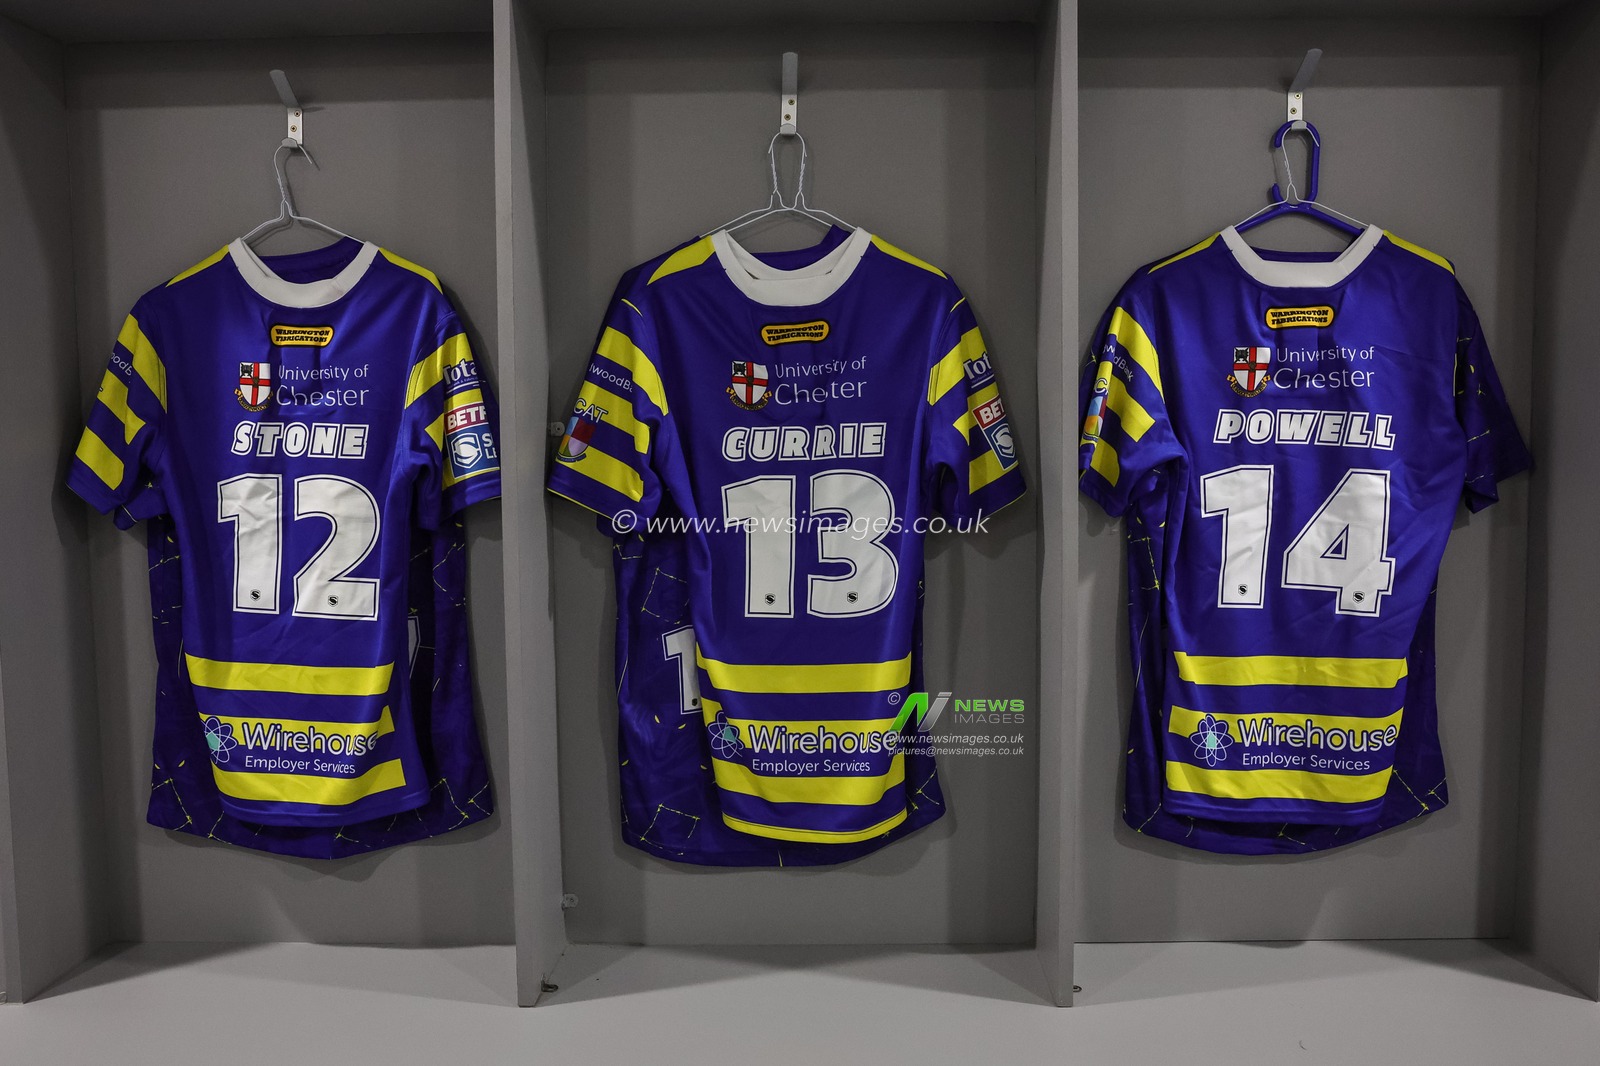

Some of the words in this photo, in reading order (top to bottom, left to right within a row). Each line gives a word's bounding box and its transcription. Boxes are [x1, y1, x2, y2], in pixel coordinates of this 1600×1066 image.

[1270, 309, 1329, 318] WARRINGTON
[1277, 346, 1356, 362] University
[1360, 346, 1375, 360] of
[278, 365, 350, 381] University
[354, 364, 369, 378] of
[774, 359, 848, 379] University
[851, 355, 867, 370] of
[1273, 368, 1375, 389] Chester
[276, 385, 370, 407] Chester
[774, 380, 867, 405] Cheter
[230, 420, 369, 460] STONE
[721, 422, 887, 462] CURRIE
[1212, 408, 1396, 451] POWELL
[217, 472, 381, 621] 12
[721, 469, 899, 618] 13
[1200, 464, 1396, 618] 14
[242, 722, 378, 757] Wirehouse
[749, 724, 899, 755] Wirehouse
[1238, 717, 1397, 753] Wirehouse
[245, 755, 311, 773] Employer
[313, 758, 356, 774] Services
[752, 758, 820, 775] Employer
[823, 759, 871, 772] Services
[1242, 751, 1307, 768] Employer
[1310, 754, 1371, 771] Services
